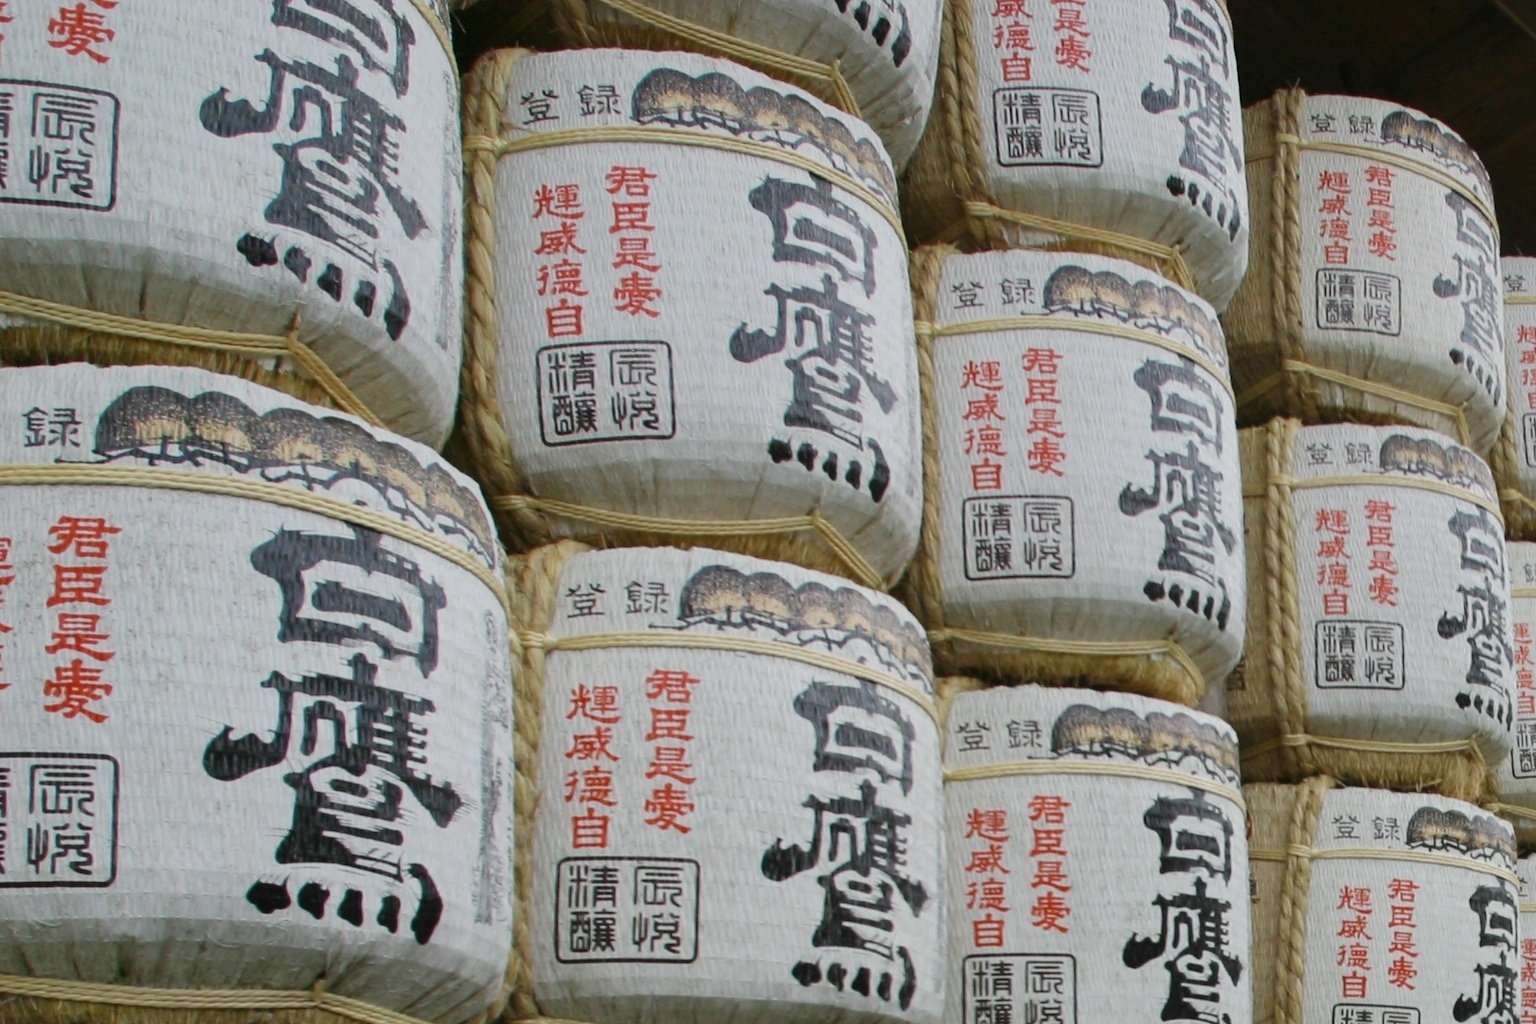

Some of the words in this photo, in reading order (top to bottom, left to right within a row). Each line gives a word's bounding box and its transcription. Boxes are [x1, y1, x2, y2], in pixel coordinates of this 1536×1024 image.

[520, 84, 621, 125] 登録
[1310, 113, 1376, 135] 登録
[951, 278, 1037, 309] 登録
[729, 172, 899, 503] 白鷹
[1306, 442, 1373, 465] 登録
[1119, 357, 1236, 632] 白鷹
[565, 580, 670, 619] 登録
[203, 522, 464, 944] 白鷹
[957, 719, 1043, 752] 登録
[762, 677, 930, 1011] 白鷹
[1331, 815, 1401, 841] 登録
